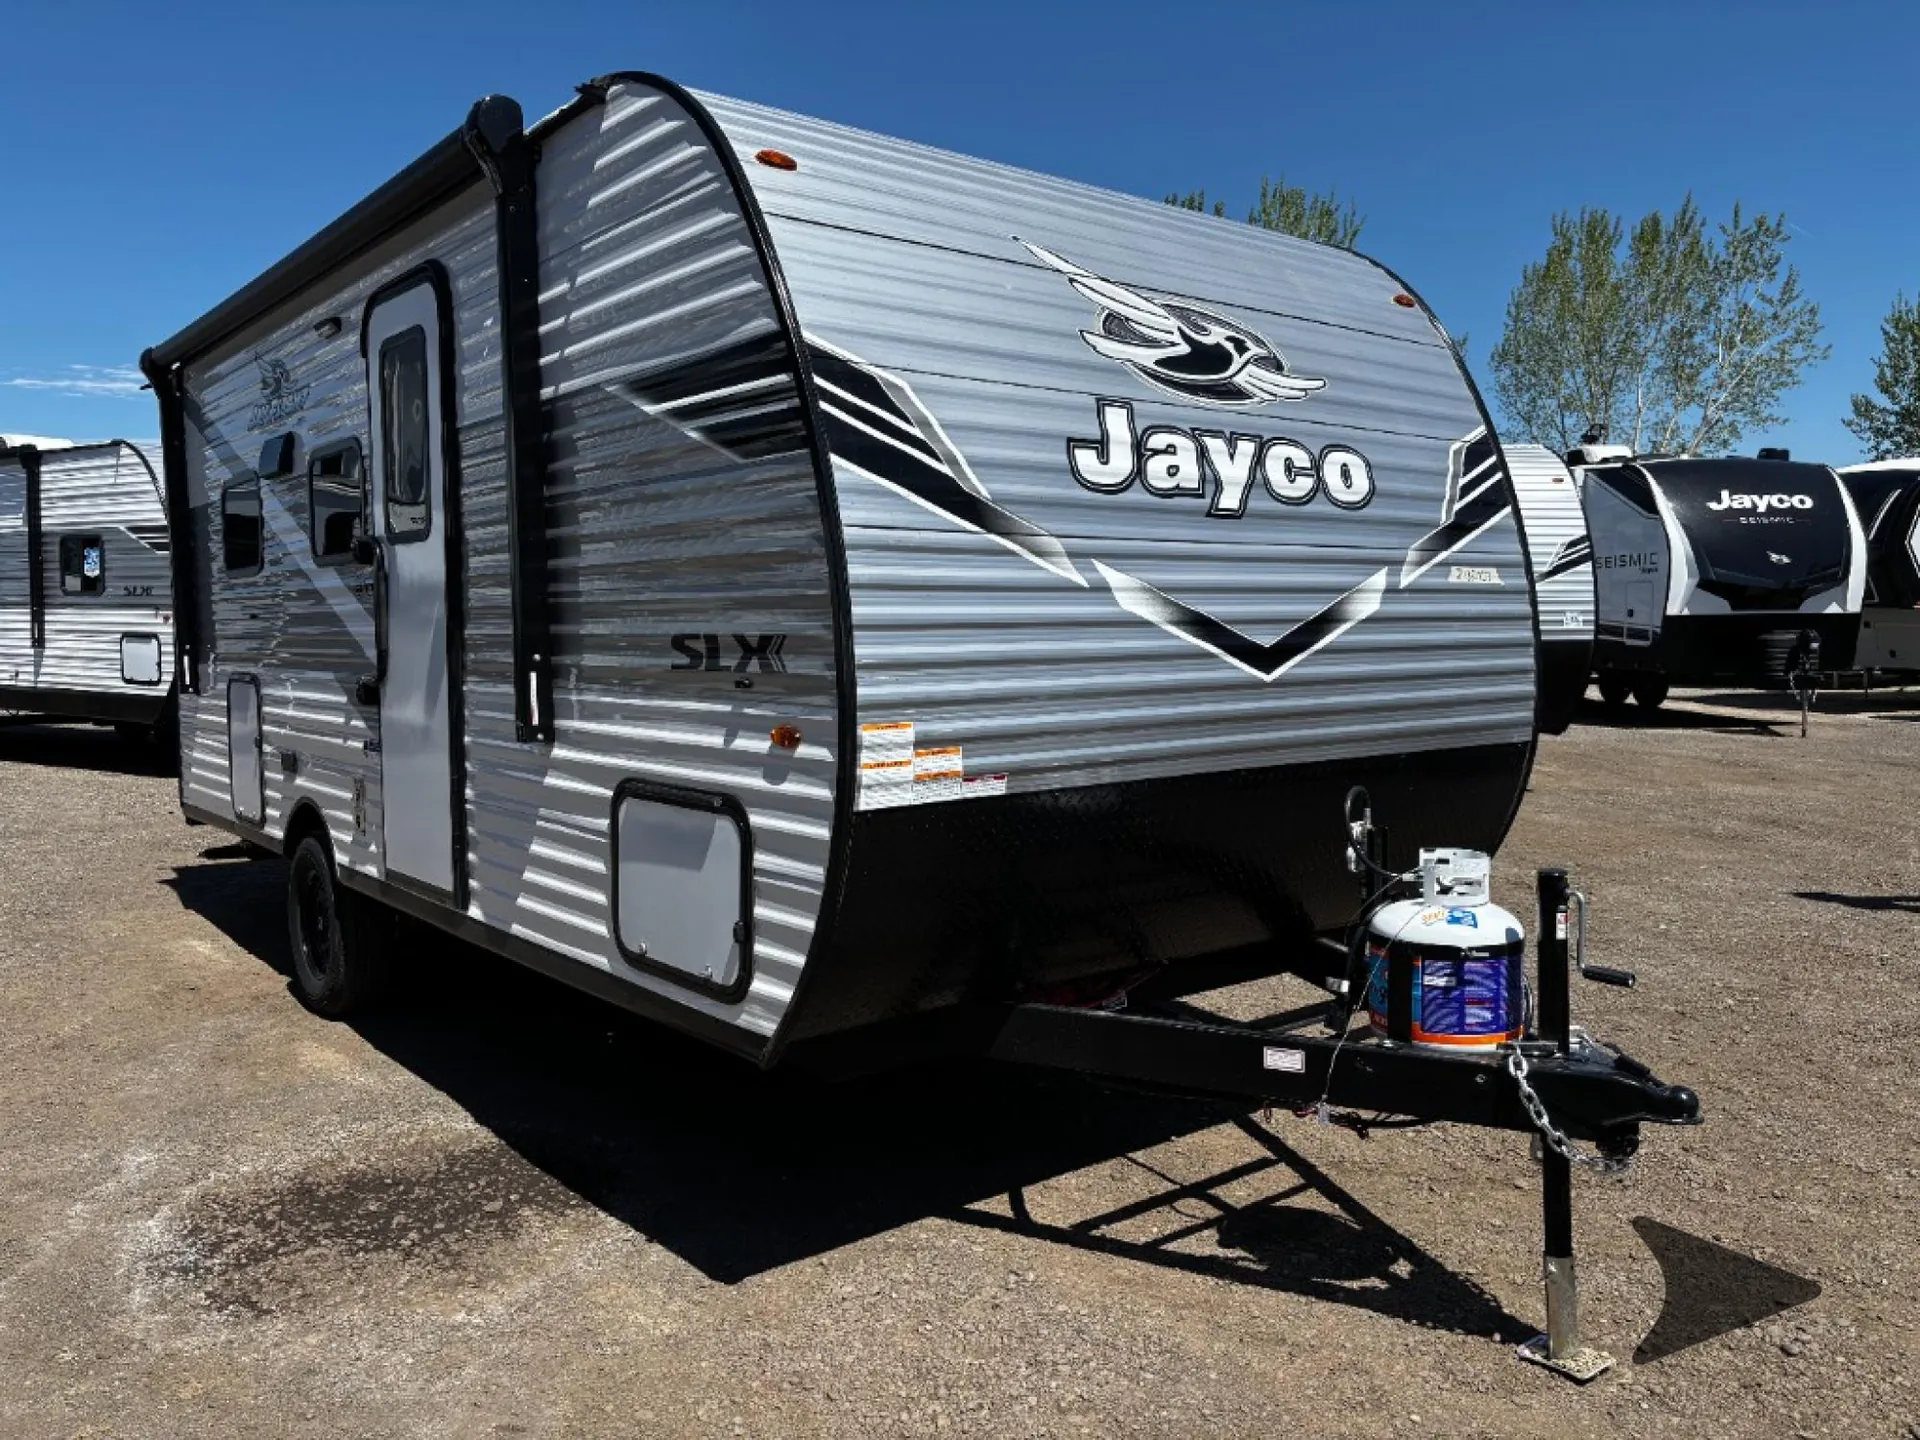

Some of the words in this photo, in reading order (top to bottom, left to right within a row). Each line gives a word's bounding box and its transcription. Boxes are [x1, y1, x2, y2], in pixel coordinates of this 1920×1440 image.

[1067, 398, 1376, 519] Jayco
[1706, 490, 1814, 512] Jayco
[1596, 552, 1658, 569] SEISMIC
[671, 634, 787, 673] SLX
